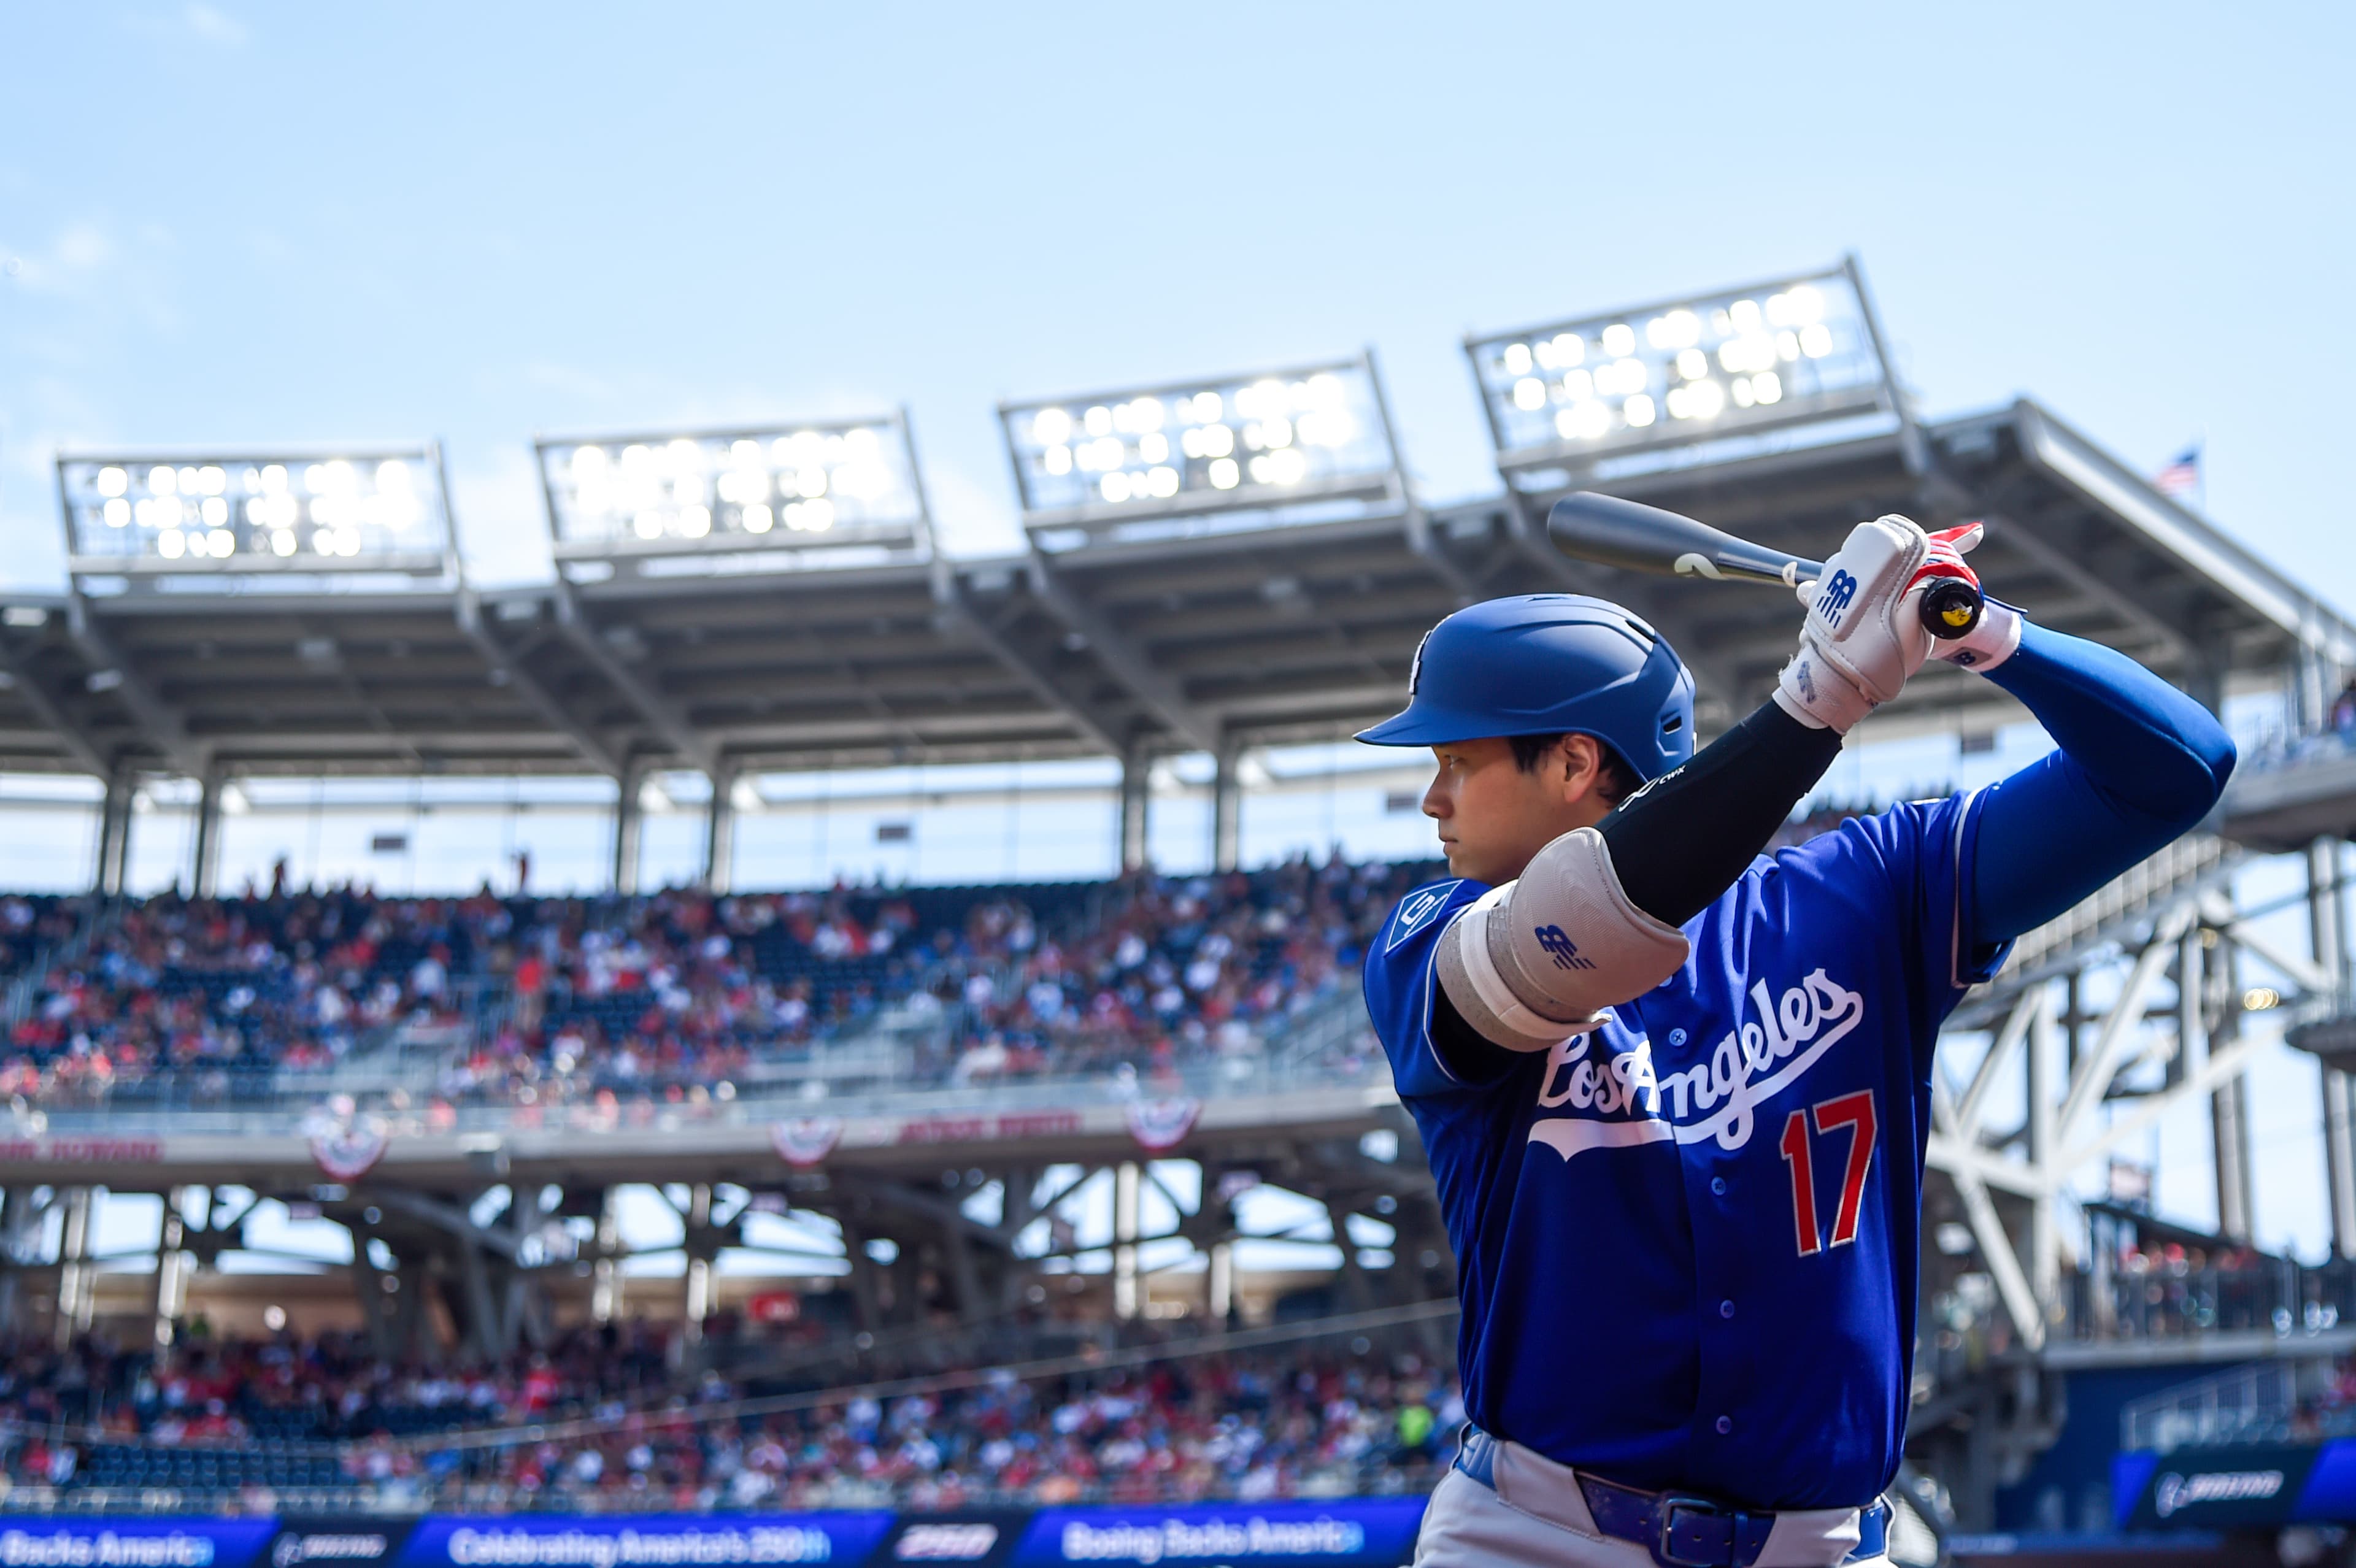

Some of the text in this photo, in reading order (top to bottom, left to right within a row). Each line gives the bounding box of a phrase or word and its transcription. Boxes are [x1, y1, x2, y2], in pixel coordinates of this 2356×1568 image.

[1537, 968, 1863, 1151] Los Angeles
[1780, 1088, 1878, 1258] 17
[448, 1527, 615, 1568] Celebrating
[1061, 1521, 1162, 1565] Boeing
